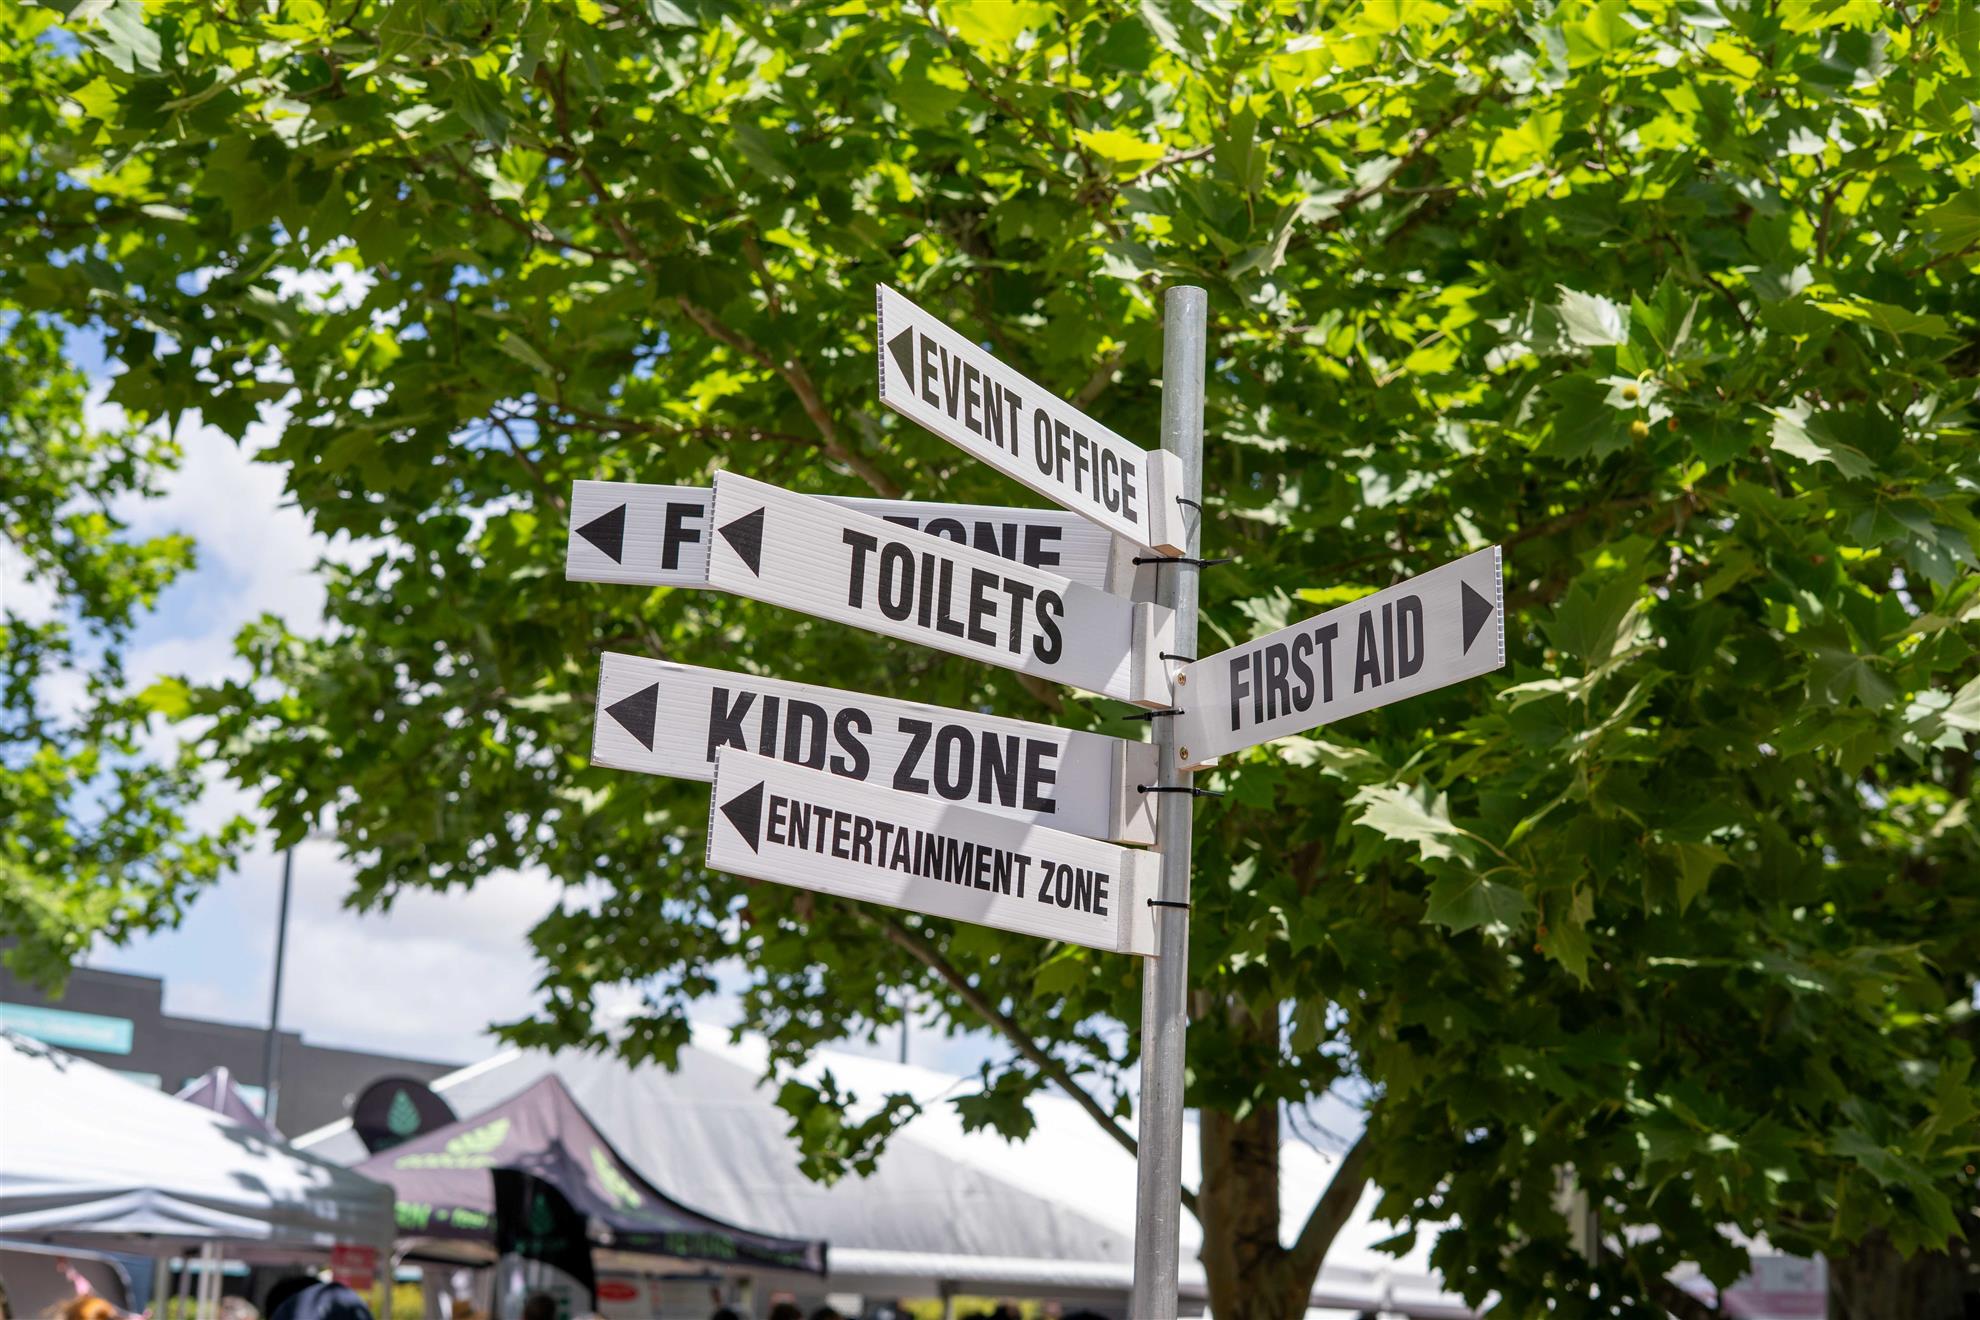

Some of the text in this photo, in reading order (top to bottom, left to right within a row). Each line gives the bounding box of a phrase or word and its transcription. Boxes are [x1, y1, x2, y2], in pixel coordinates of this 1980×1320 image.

[920, 332, 1138, 525] EVENT OFFICE
[842, 528, 1064, 664] TOILETS
[1230, 595, 1424, 731] FIRST AID
[706, 687, 1059, 814] KIDS ZONE
[766, 795, 1110, 916] ENTERTAINMENT ZONE
